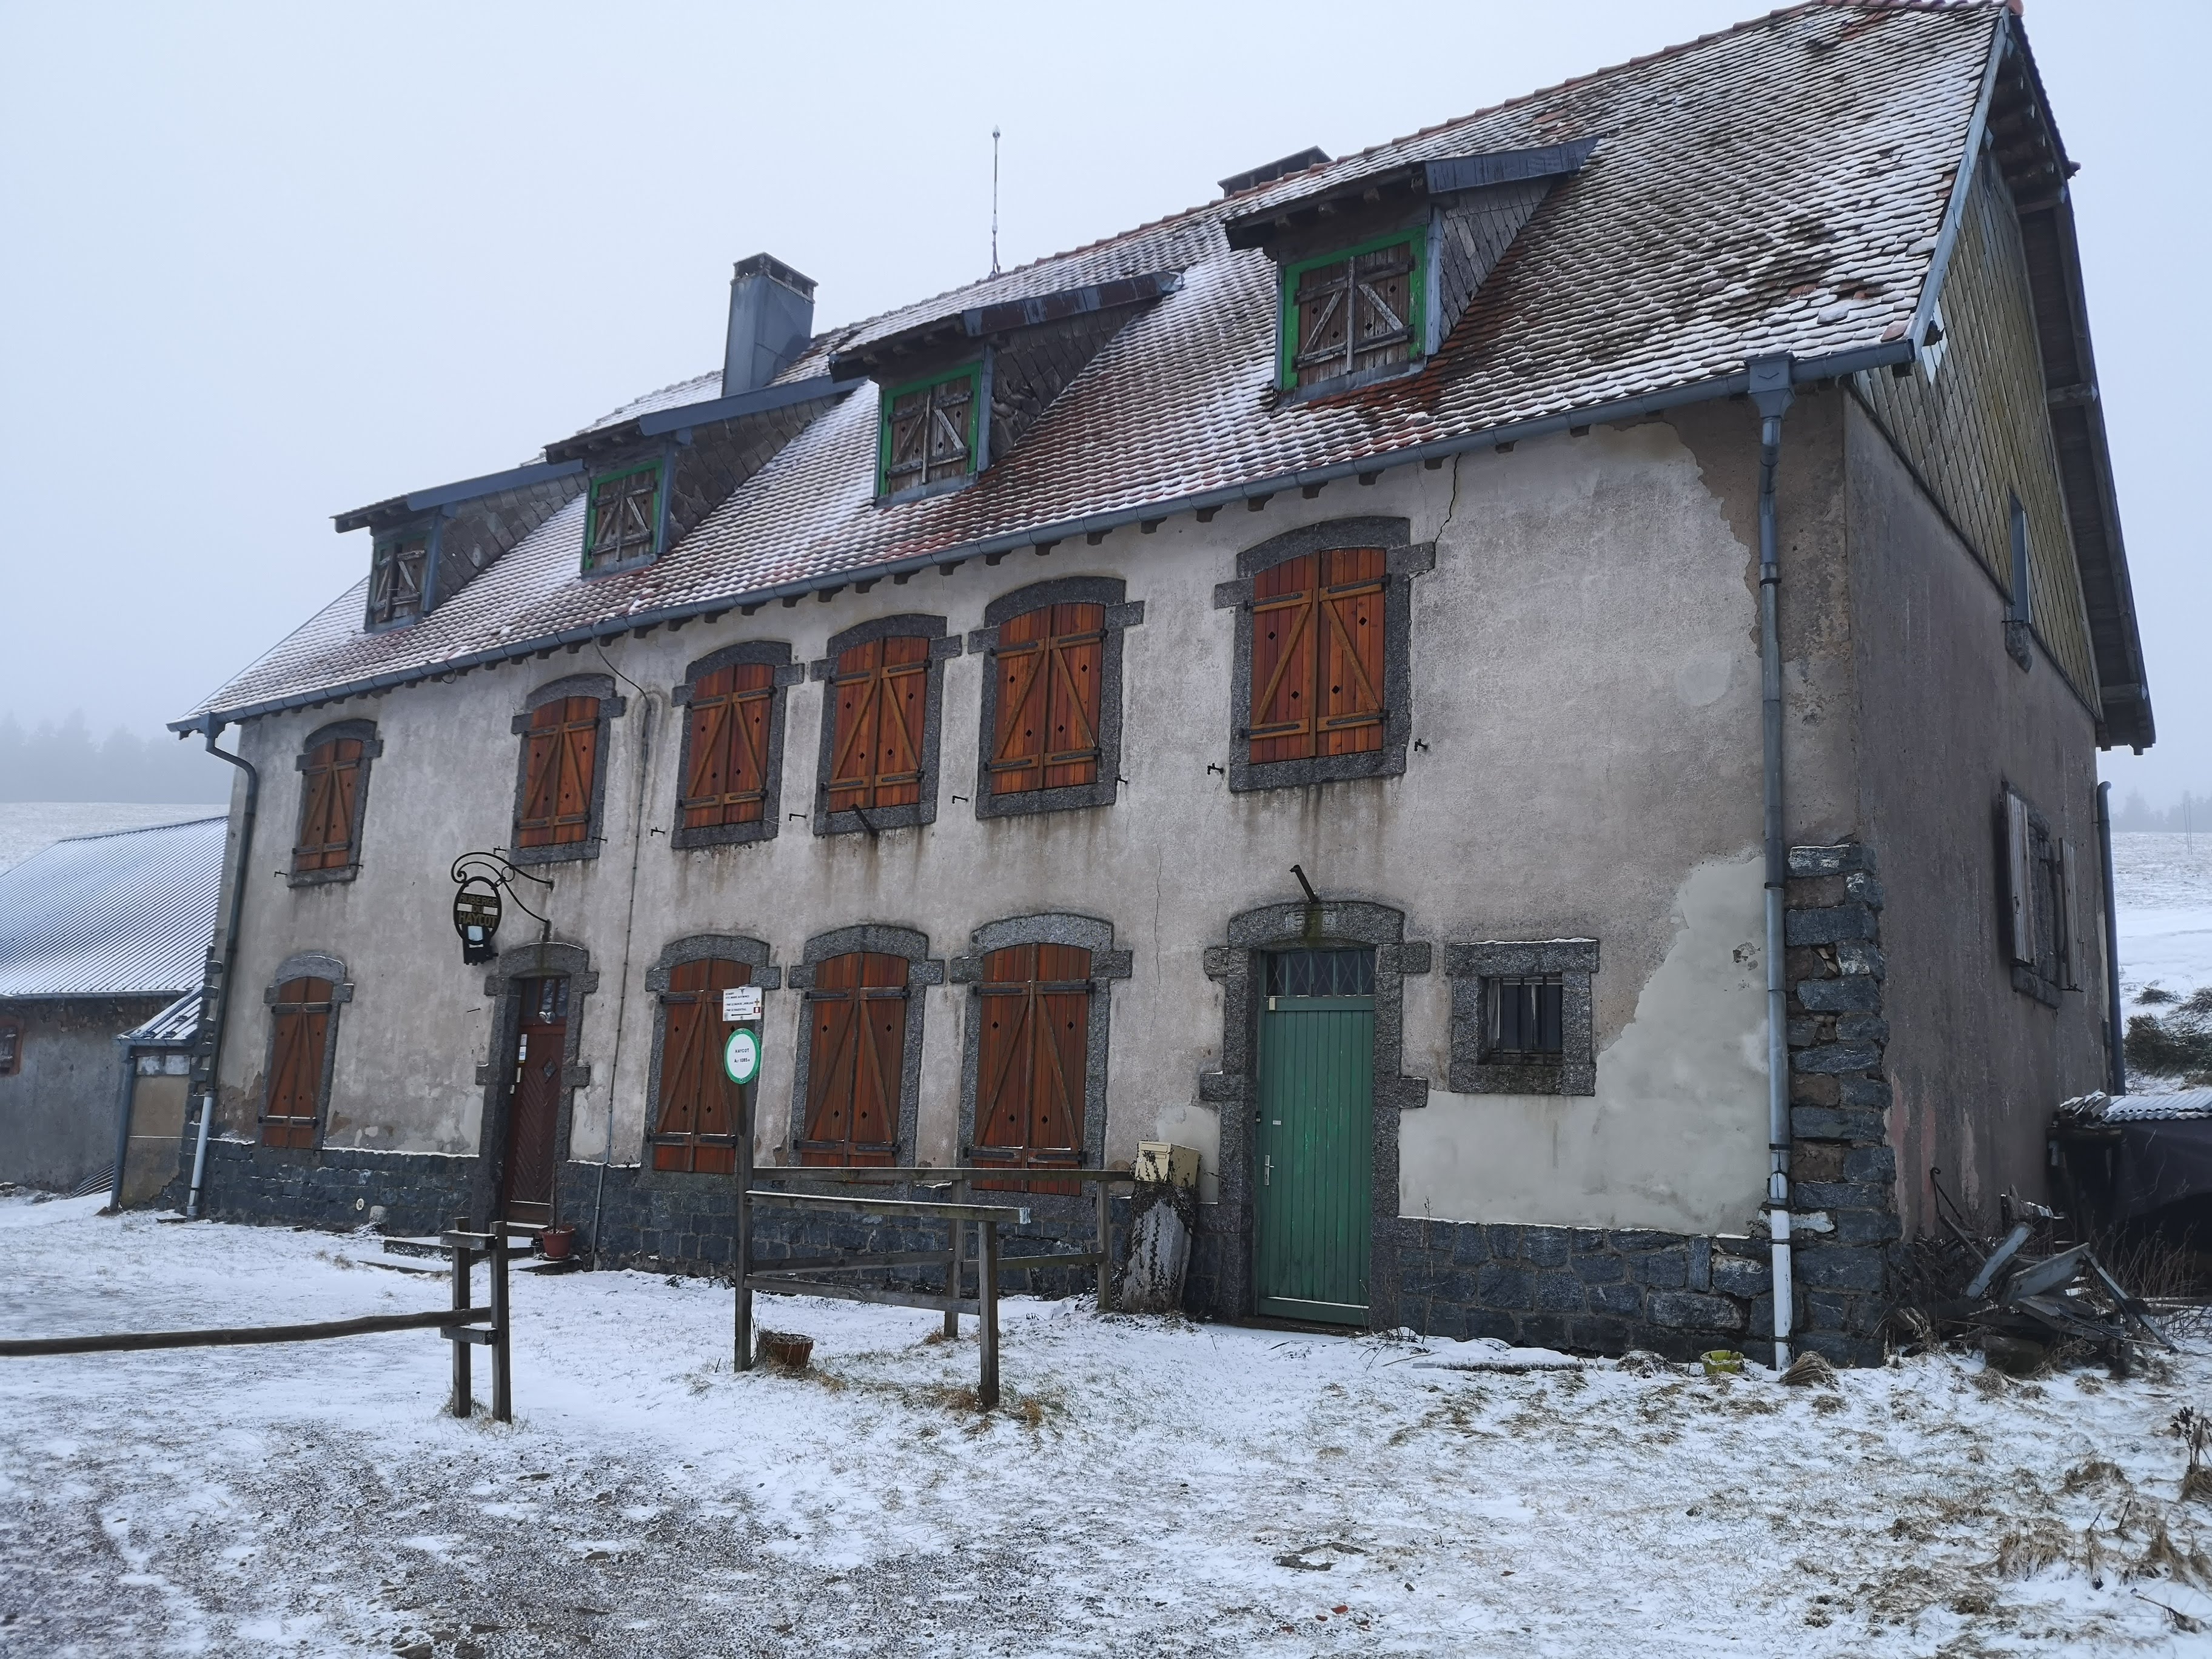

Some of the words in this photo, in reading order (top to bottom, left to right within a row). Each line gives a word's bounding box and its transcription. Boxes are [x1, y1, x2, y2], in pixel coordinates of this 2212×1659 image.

[459, 894, 498, 907] AUBERGE
[473, 905, 483, 913] DU
[458, 911, 498, 928] HAYCOT
